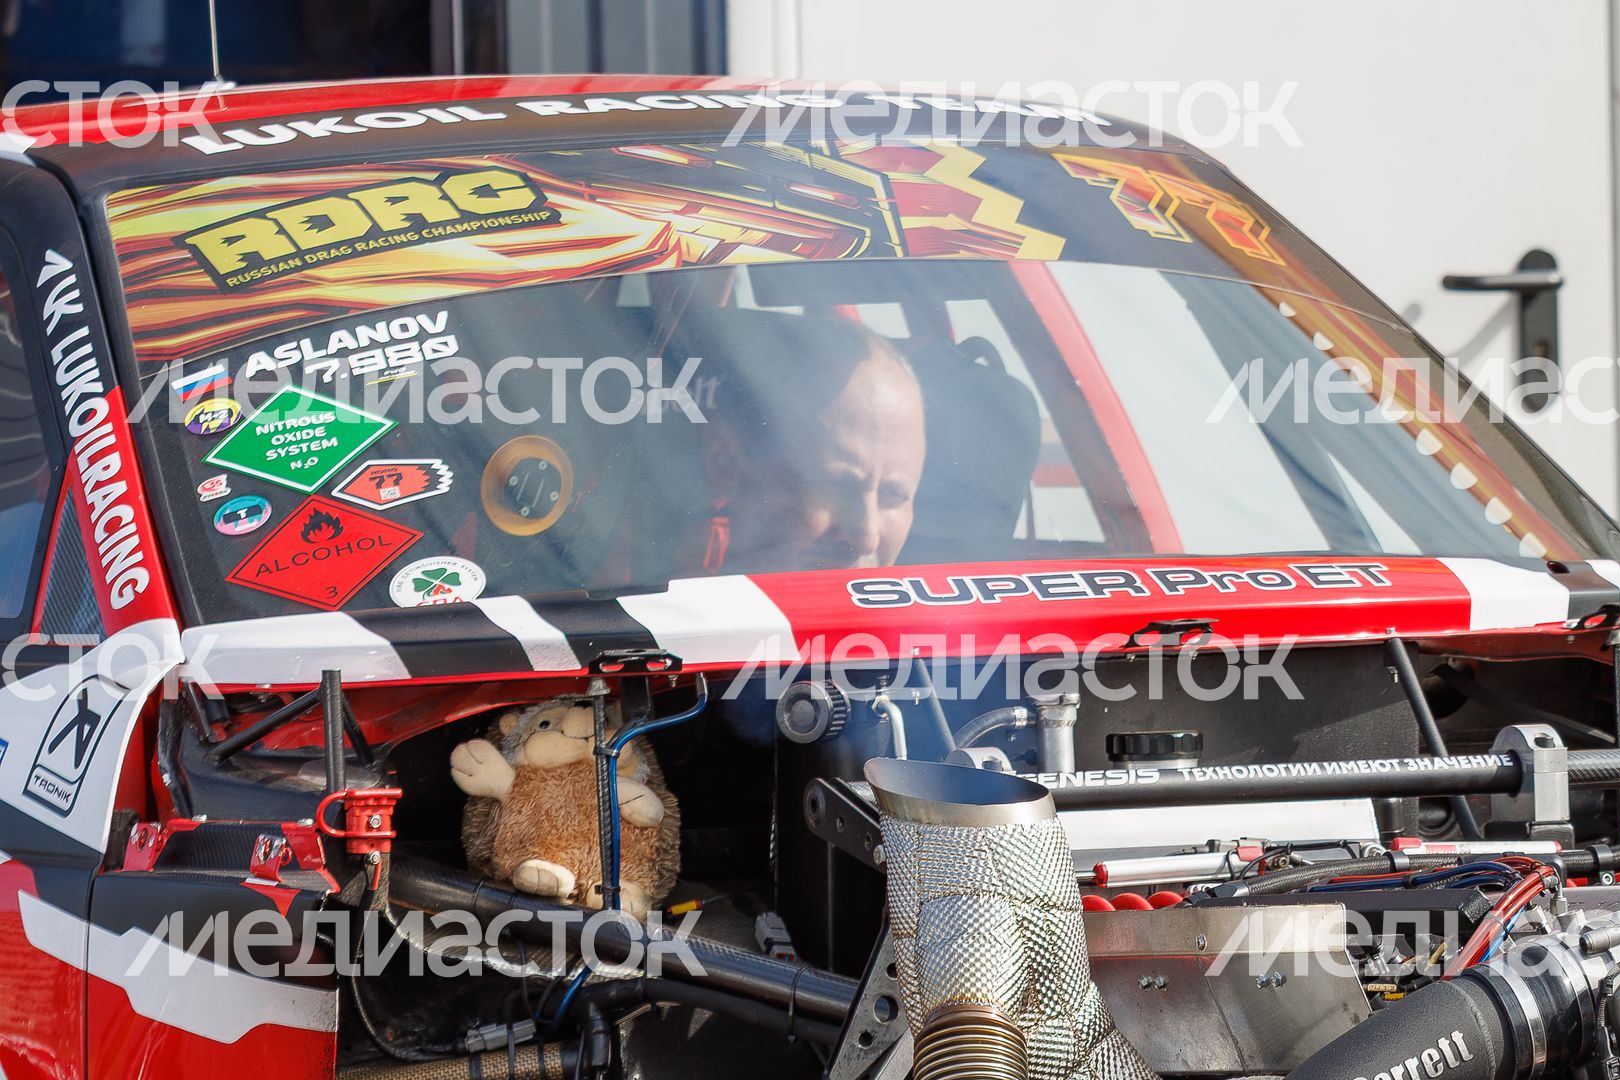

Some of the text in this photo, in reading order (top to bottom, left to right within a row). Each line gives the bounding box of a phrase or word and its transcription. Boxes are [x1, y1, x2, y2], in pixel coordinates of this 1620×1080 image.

[181, 105, 507, 155] LUKOIL
[515, 94, 844, 116] RACING
[226, 209, 552, 287] RUSSIAN DRAG RACING CHAMPIONSHIP
[245, 310, 450, 378] ASLANOV
[303, 334, 461, 384] 7.980
[255, 411, 337, 436] NITROUS
[271, 425, 328, 447] OXIDE
[265, 436, 338, 462] SYSTEM
[254, 534, 394, 578] ALCOHOL
[325, 586, 339, 600] 3
[850, 561, 1394, 609] SUPER Pro ET
[1177, 752, 1514, 782] ТЕХНОЛОГИИ ИМЕЮТ ЗНАЧЕНИЕ
